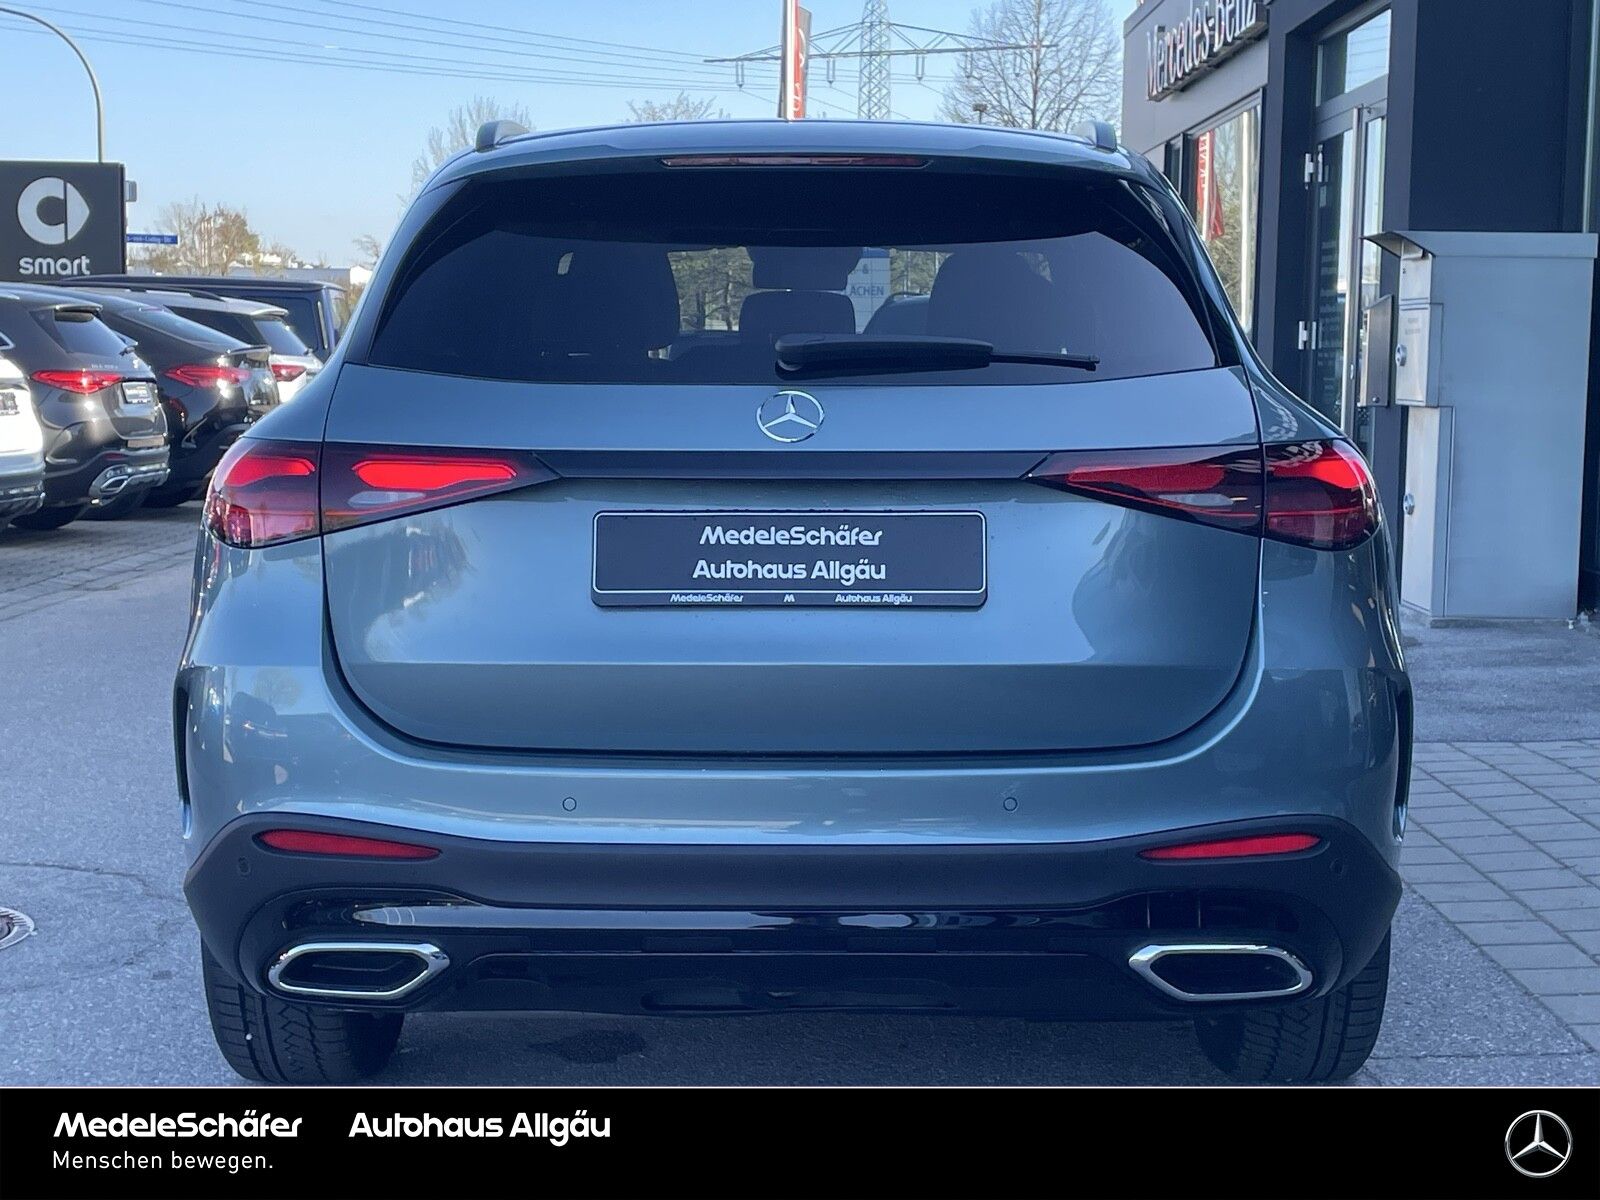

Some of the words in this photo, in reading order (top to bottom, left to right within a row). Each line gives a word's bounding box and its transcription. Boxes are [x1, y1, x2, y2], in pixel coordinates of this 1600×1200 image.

[19, 255, 91, 275] smart
[699, 525, 883, 546] MedeleSchäfer
[692, 559, 808, 580] Autohaus
[810, 559, 886, 586] Allgäu
[669, 593, 744, 603] MedeleSchäfer
[834, 593, 881, 603] Autohaus
[881, 593, 913, 606] Allgäu
